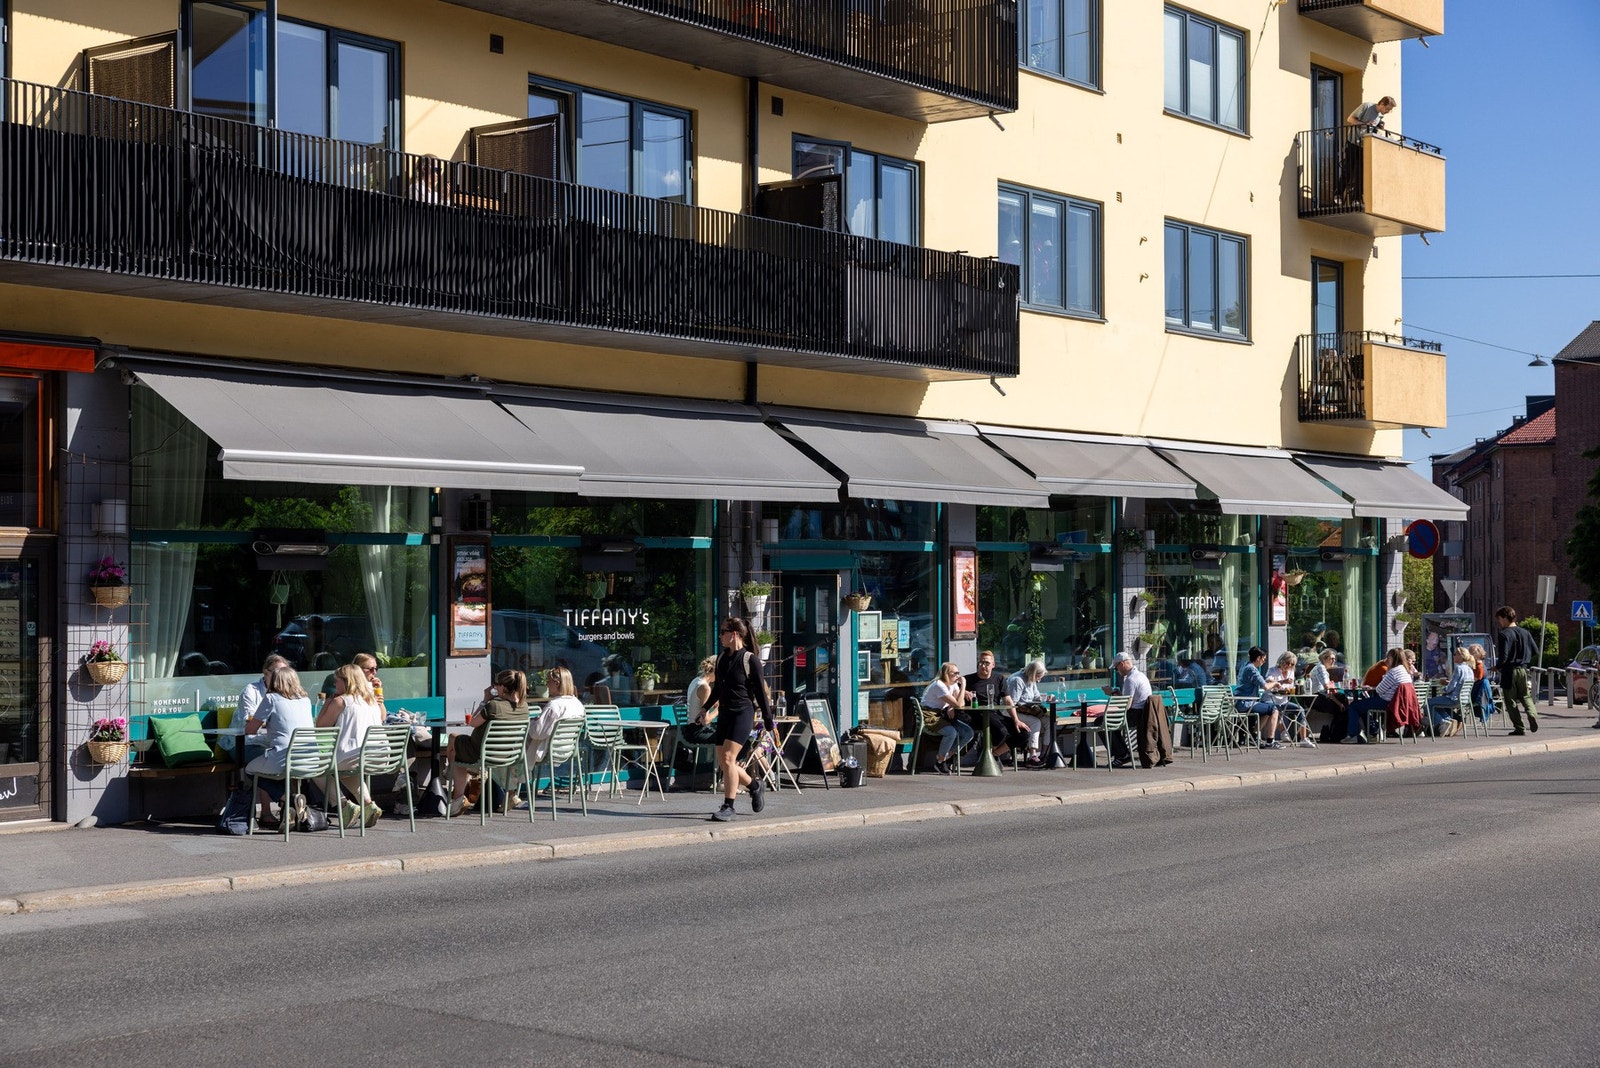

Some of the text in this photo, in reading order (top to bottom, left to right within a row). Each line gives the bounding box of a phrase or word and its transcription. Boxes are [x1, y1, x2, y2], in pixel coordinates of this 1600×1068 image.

[1179, 596, 1225, 609] TIFFANY's
[562, 607, 650, 627] TIFFANY's
[578, 631, 635, 642] burgers and bowls
[153, 698, 190, 706] HOMEMADE
